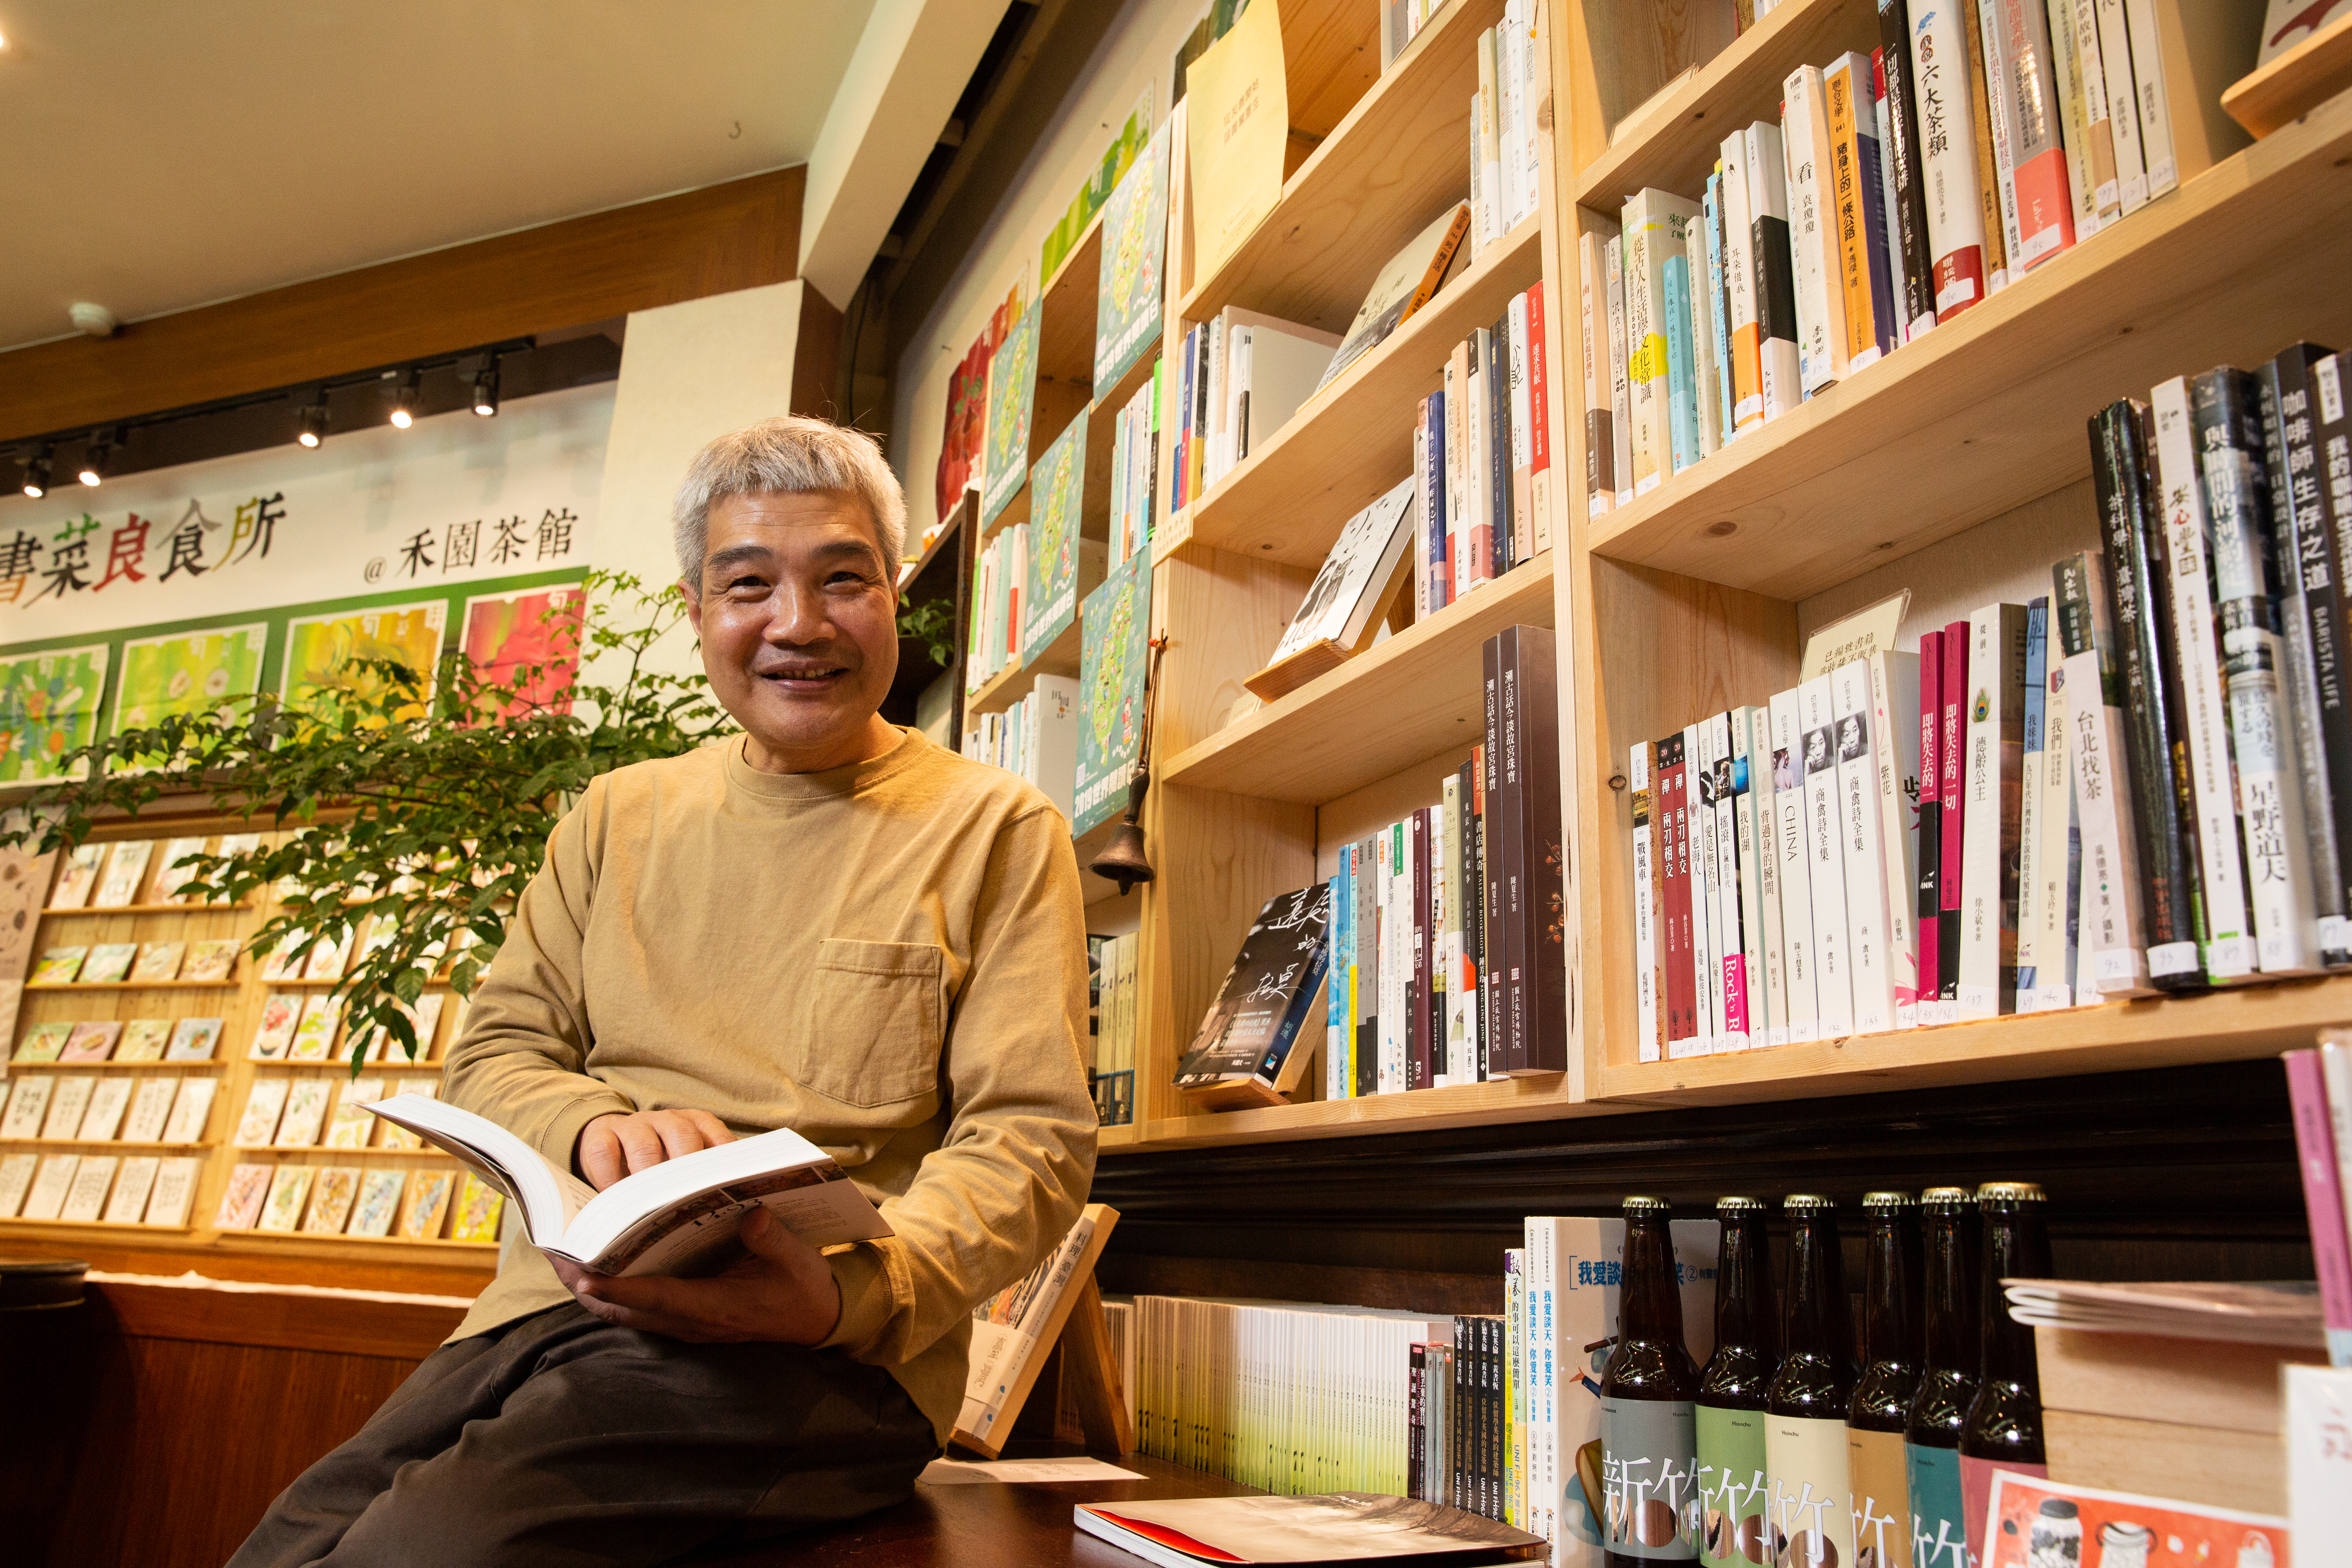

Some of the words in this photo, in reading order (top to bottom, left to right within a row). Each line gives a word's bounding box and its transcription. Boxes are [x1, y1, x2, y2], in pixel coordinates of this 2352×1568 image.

[1832, 78, 1843, 118] 聯合文學
[1920, 65, 1948, 163] 六大茶類
[1836, 122, 1845, 133] 641
[1797, 162, 1812, 184] 看
[1836, 142, 1855, 242] 豬身上的一條公路
[1802, 194, 1815, 234] 袁瓊瓊
[1731, 248, 1745, 294] 耳朵借我
[1848, 254, 1857, 275] 馮傑
[1633, 235, 1652, 405] 從古人生活學文化常識
[1532, 343, 1541, 385] 速求共眠
[2281, 389, 2331, 590] 咖啡師生存之道
[364, 557, 387, 584] @
[396, 508, 579, 579] 禾園茶館
[1824, 632, 1875, 662] 已編號書籍
[1486, 678, 1496, 792] 溯古話今談故宮珠寶
[1505, 669, 1516, 784] 溯古話今談故宮珠寶
[2027, 714, 2037, 751] 我妹妹
[2051, 717, 2062, 751] 我們
[1922, 713, 1934, 799] 即將失去的一
[1945, 703, 1957, 811] 即將失去的一切
[1974, 736, 1986, 802] 德齡公主
[2077, 710, 2102, 801] 台北找茶
[1880, 764, 1891, 796] 紫花
[1720, 815, 1729, 844] 搖滾
[1740, 811, 1750, 853] 我的湖
[1785, 806, 1797, 863] CHINA
[1815, 788, 1829, 862] 商禽詩全集
[1849, 776, 1864, 853] 商禽詩全集
[2251, 781, 2287, 883] 星野道夫
[1662, 812, 1674, 879] 兩刃相交
[1676, 806, 1687, 875] 兩刃相交
[1691, 835, 1702, 877] 老海人
[1705, 824, 1715, 894] 愛是無名山
[1761, 809, 1774, 896] 背過身的瞬間
[1637, 842, 1647, 882] 戰風車
[1920, 881, 1934, 890] INK
[1974, 897, 1983, 926] 徐小斌
[1794, 942, 1802, 968] 陳玉慧
[1940, 992, 1954, 1000] INK
[1728, 1037, 1739, 1048] 128
[1771, 1034, 1782, 1043] 130
[1796, 1027, 1806, 1036] 131
[1481, 1049, 1485, 1061] 遠景
[1578, 1261, 1623, 1287] 我愛談
[1731, 1420, 1751, 1428] Hsinchu
